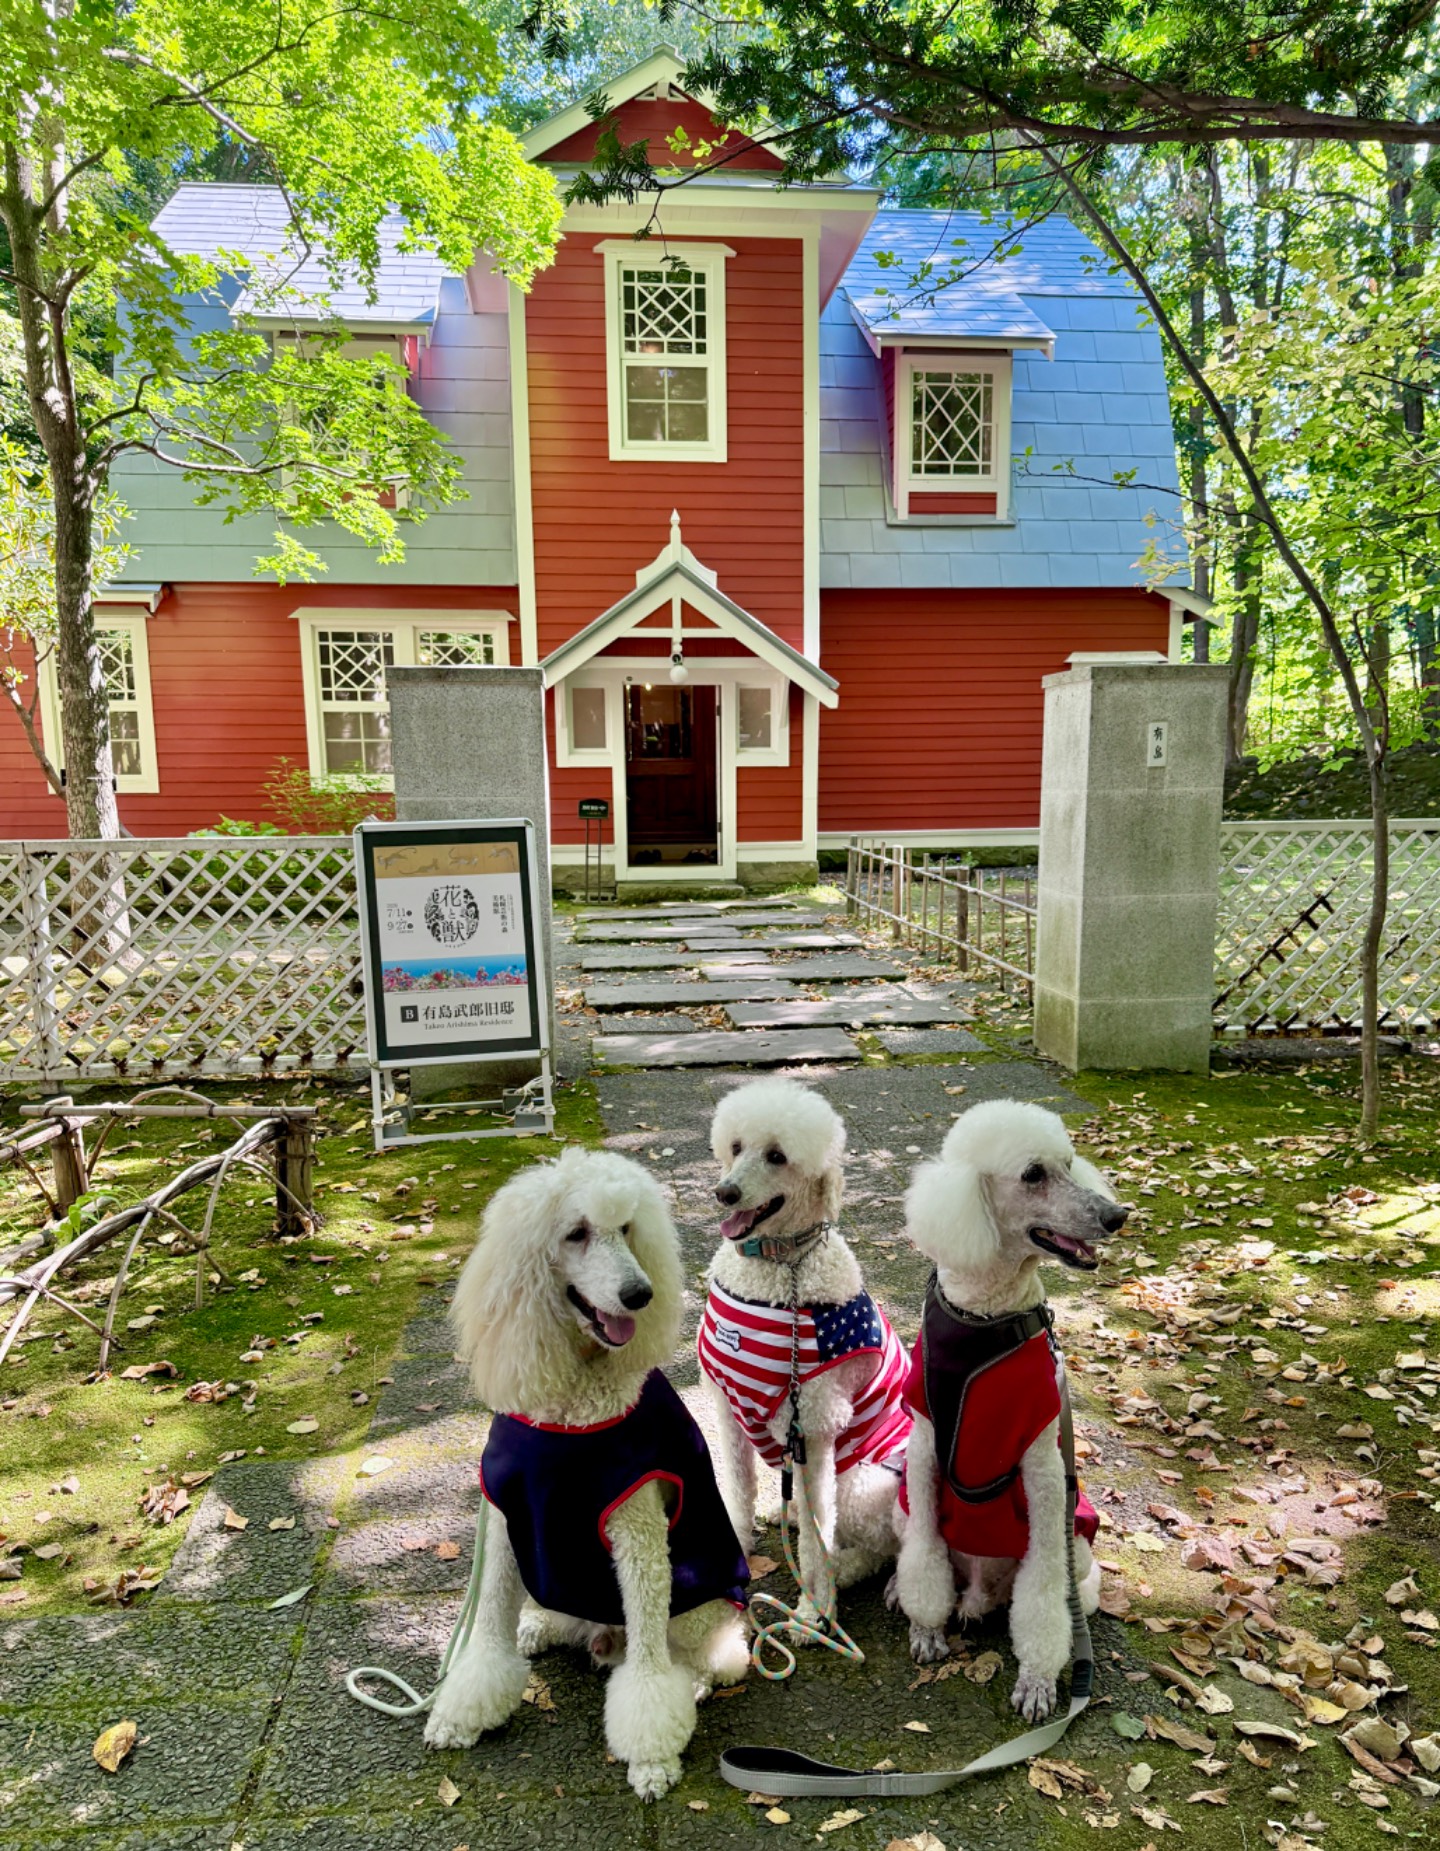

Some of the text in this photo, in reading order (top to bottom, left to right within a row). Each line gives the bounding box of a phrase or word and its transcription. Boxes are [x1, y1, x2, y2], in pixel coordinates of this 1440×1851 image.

[422, 1001, 515, 1020] 有島武郎旧邸
